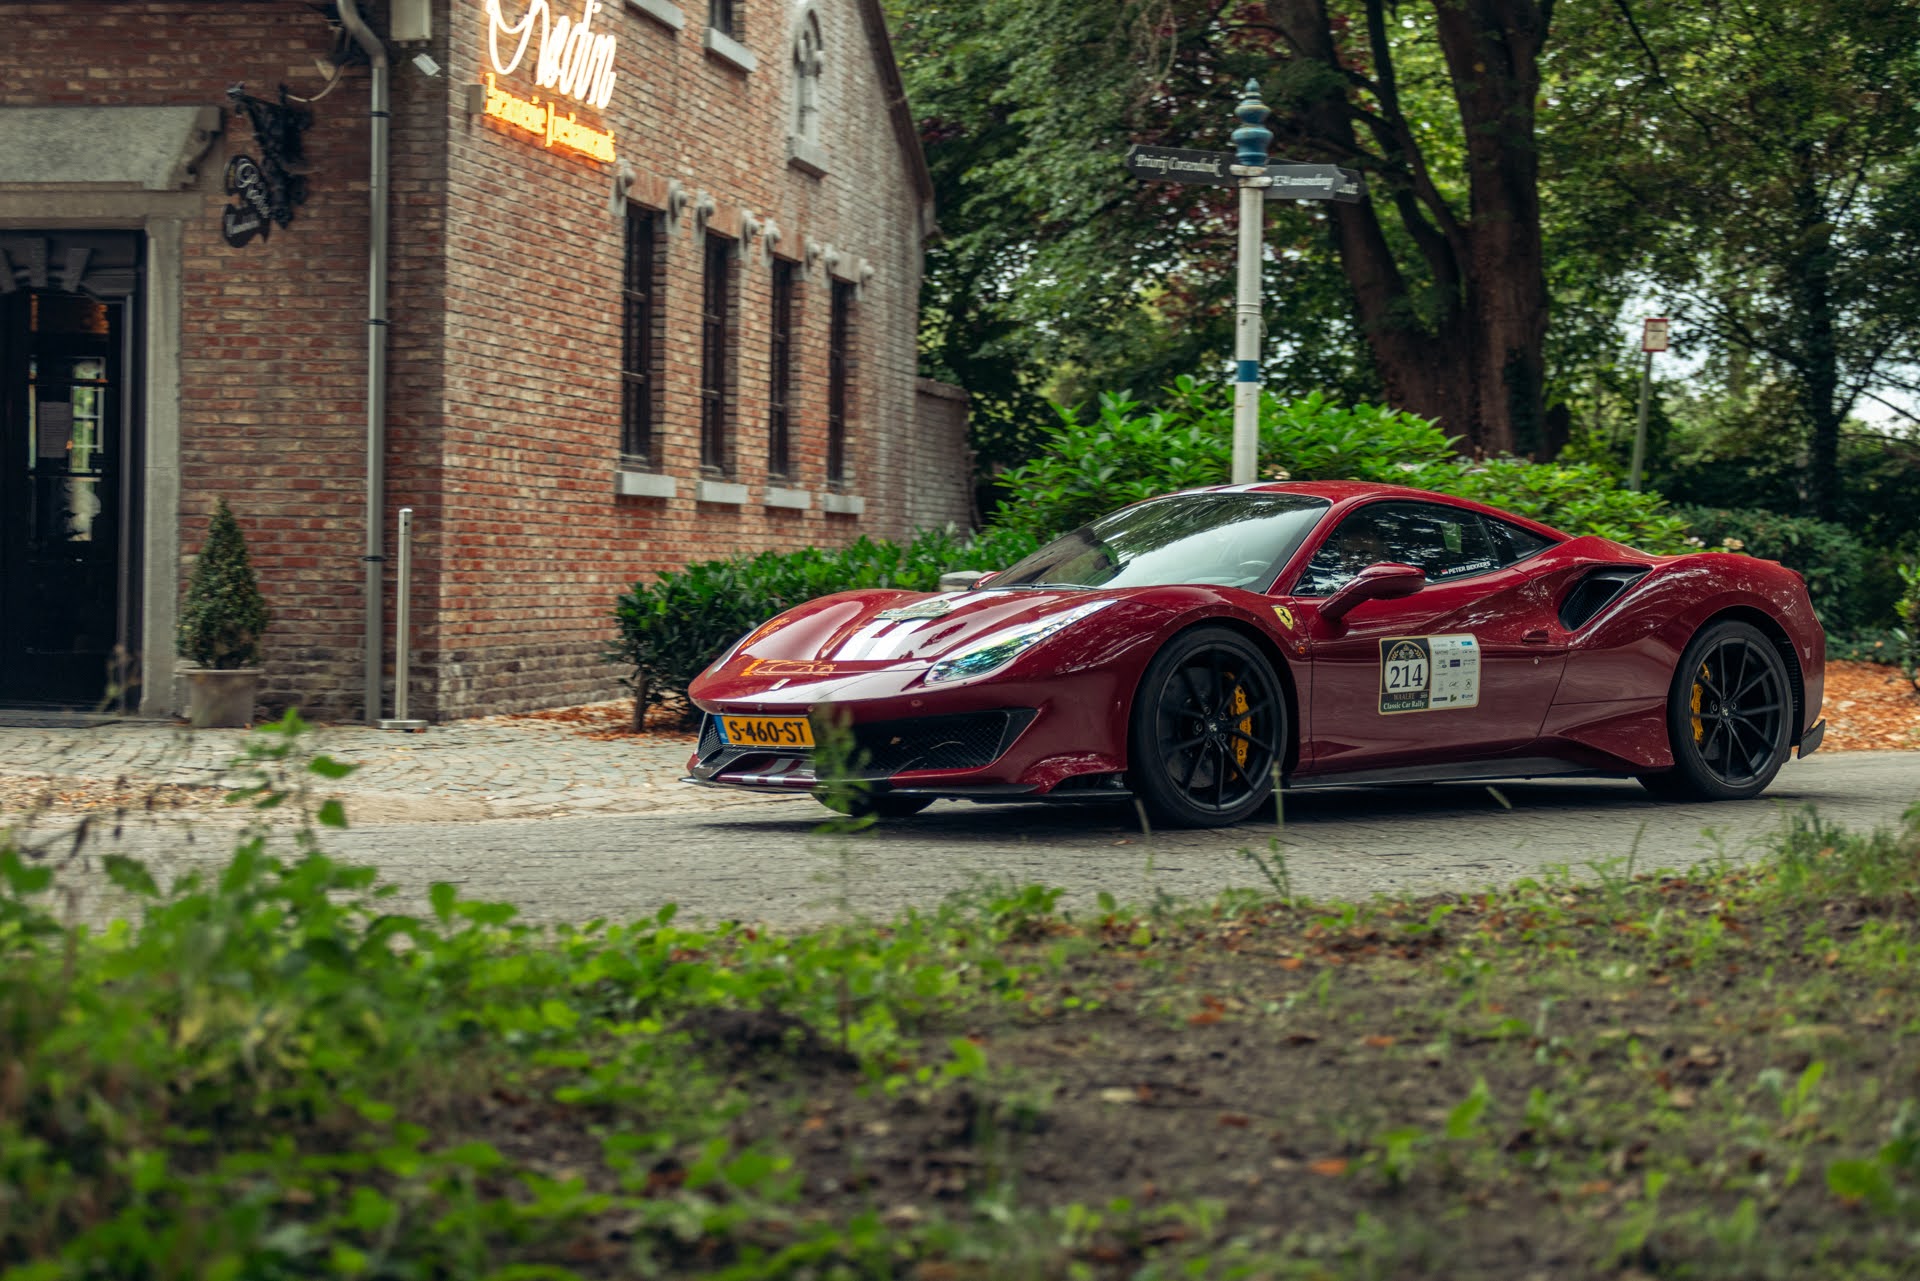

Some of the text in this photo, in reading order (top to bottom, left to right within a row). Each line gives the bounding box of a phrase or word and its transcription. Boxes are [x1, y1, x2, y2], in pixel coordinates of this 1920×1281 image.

[1448, 566, 1466, 574] PETER
[1389, 663, 1423, 688] 214
[1383, 700, 1425, 710] Classic Car Rally
[729, 720, 805, 743] S-460-ST
